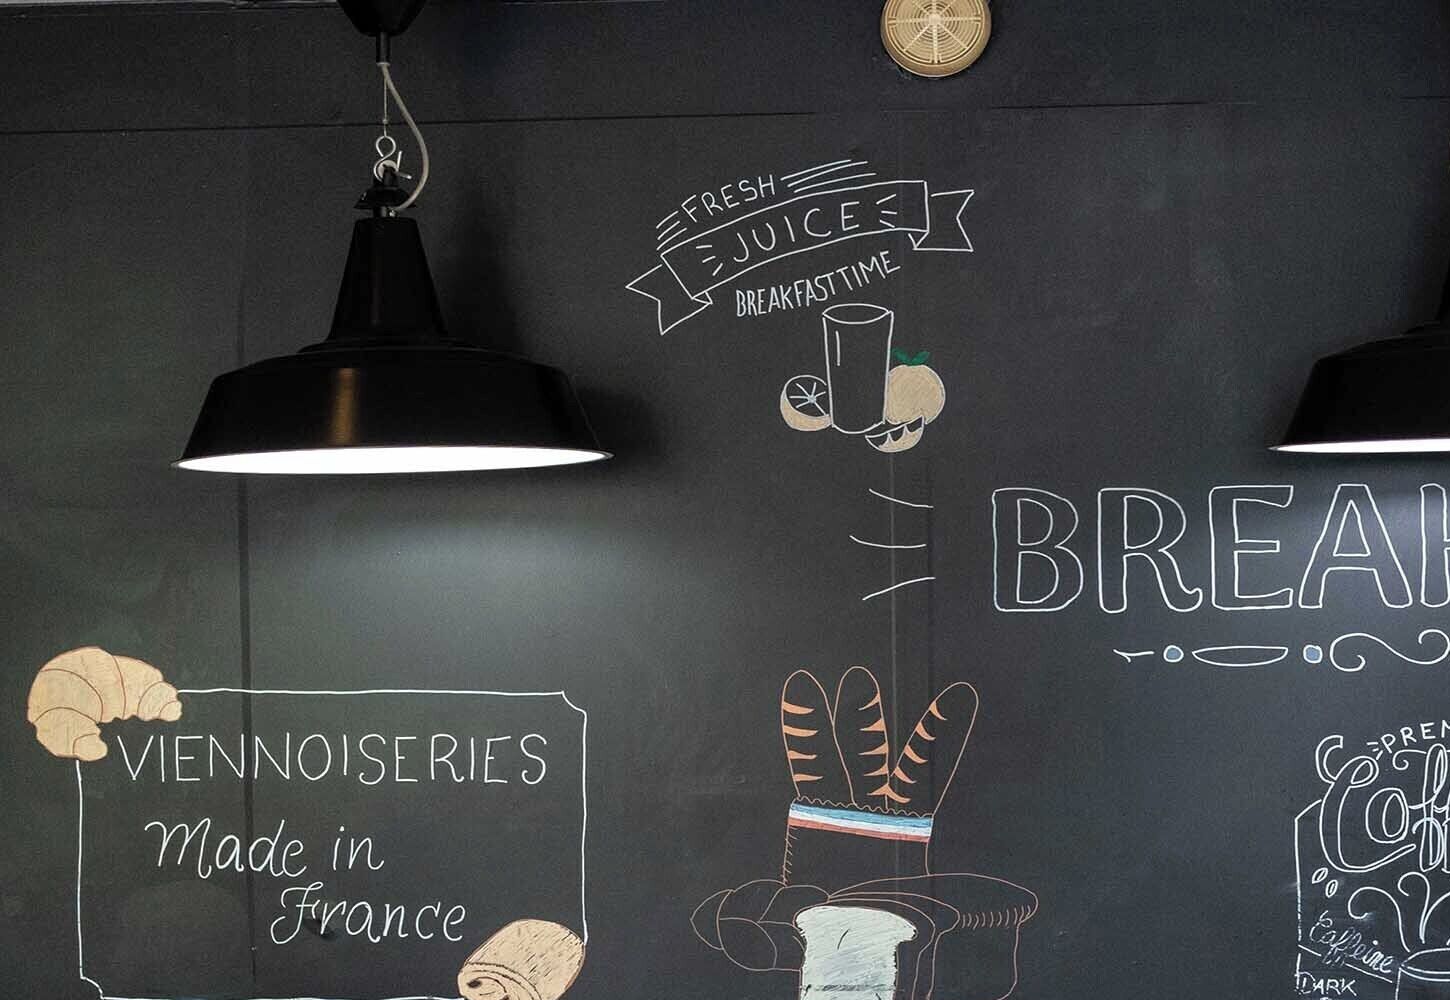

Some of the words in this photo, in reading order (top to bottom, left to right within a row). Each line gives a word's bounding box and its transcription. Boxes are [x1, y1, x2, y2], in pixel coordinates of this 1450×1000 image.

[681, 174, 775, 222] FRESH
[733, 201, 860, 262] JUICE
[117, 731, 548, 785] VIENNOISERIES
[144, 817, 307, 879] Made
[332, 826, 385, 872] in
[270, 881, 466, 944] France
[1295, 971, 1357, 997] DARK
